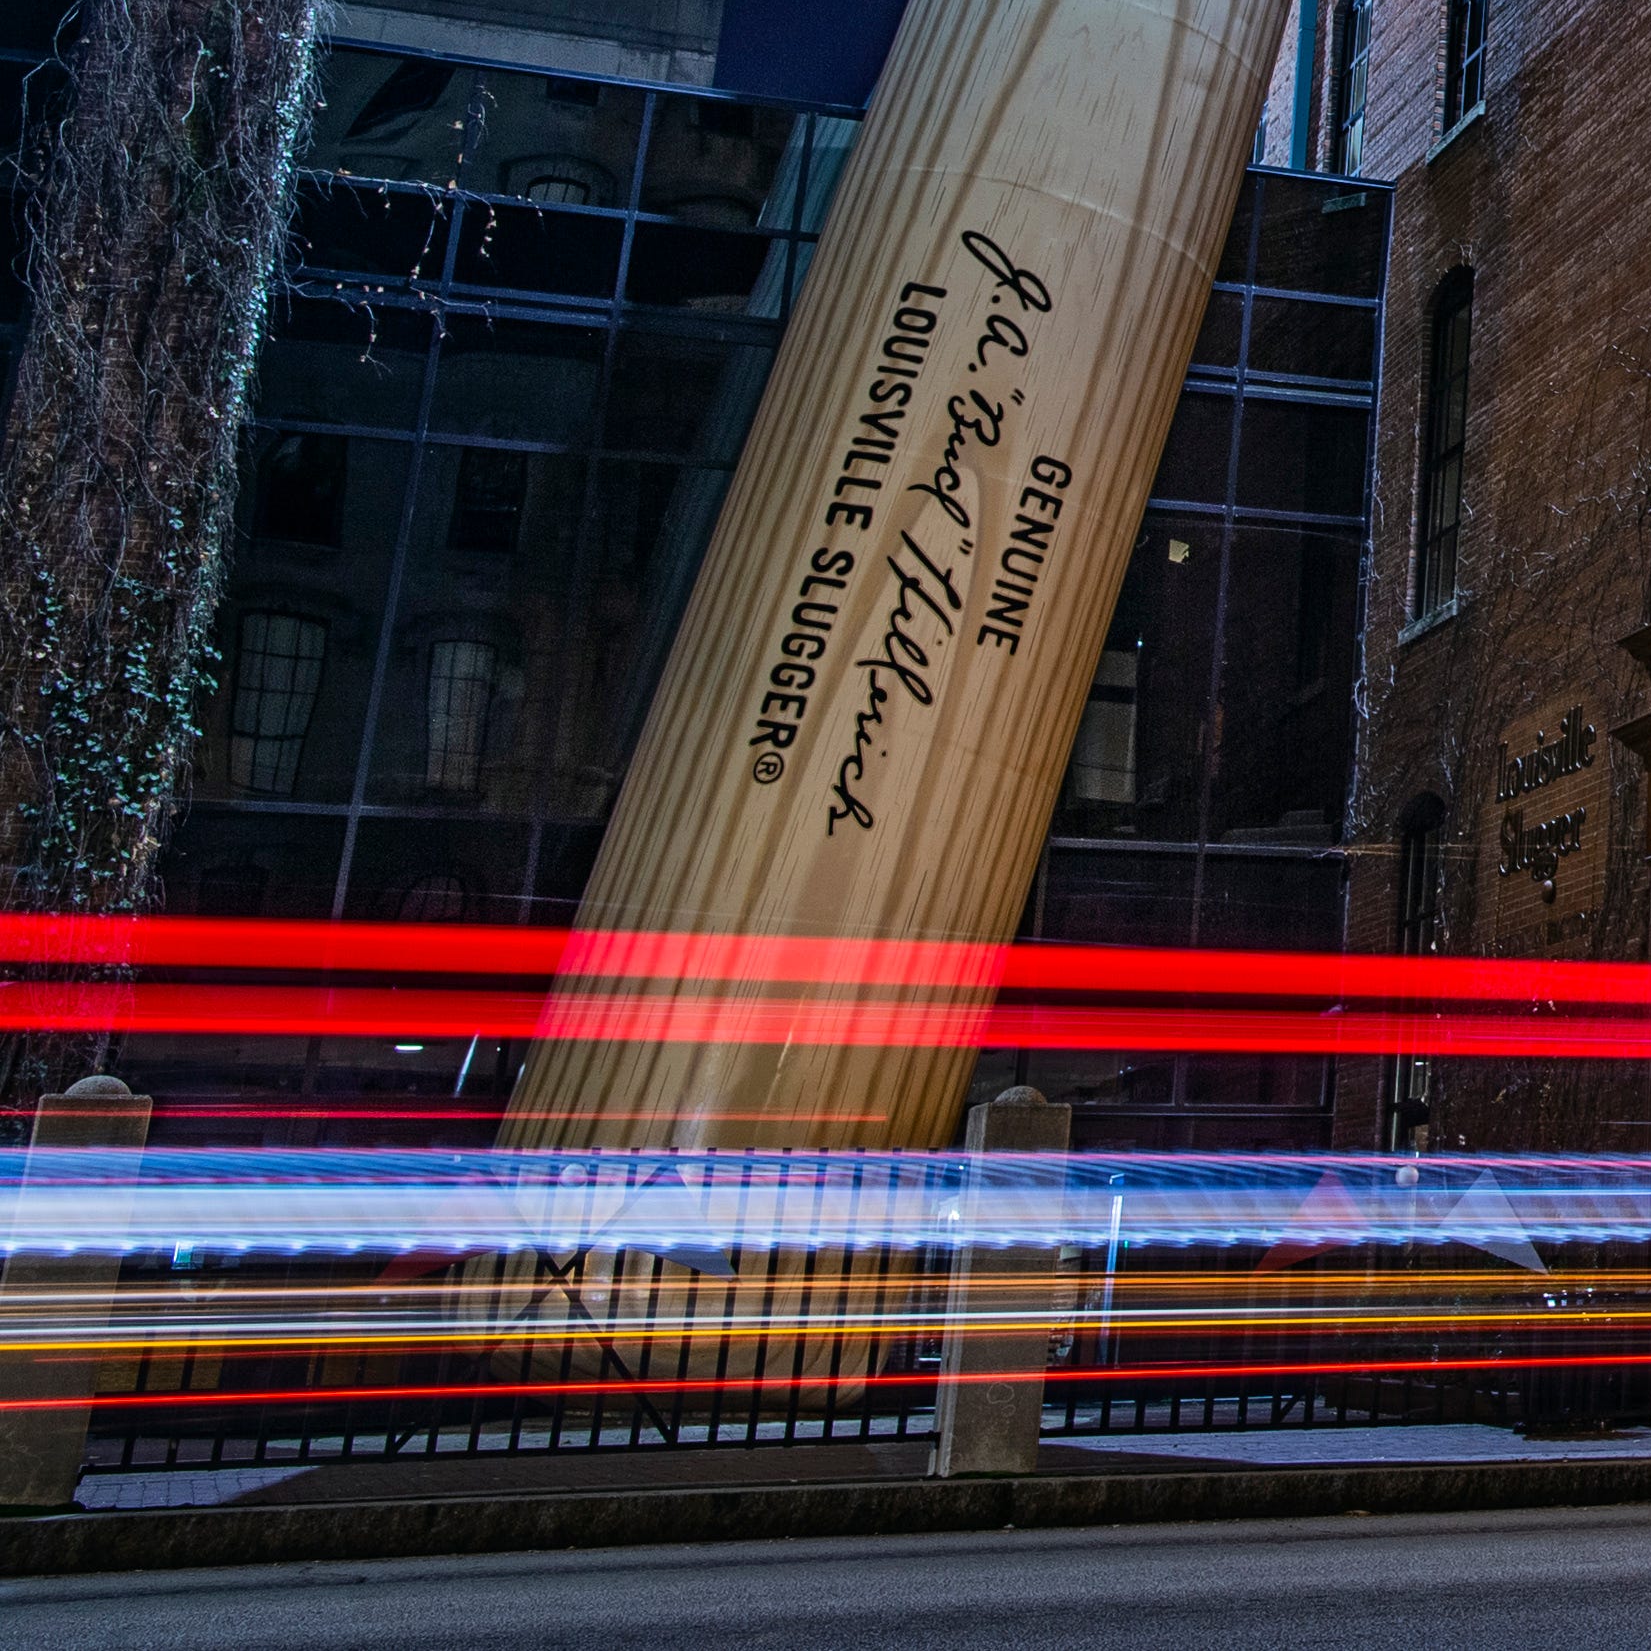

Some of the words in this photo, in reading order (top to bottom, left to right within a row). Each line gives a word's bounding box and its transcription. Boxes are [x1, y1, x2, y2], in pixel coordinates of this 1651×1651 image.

[825, 281, 948, 531] LOUISVILLE
[976, 455, 1073, 657] GENUINE
[827, 529, 962, 837] Hillerich
